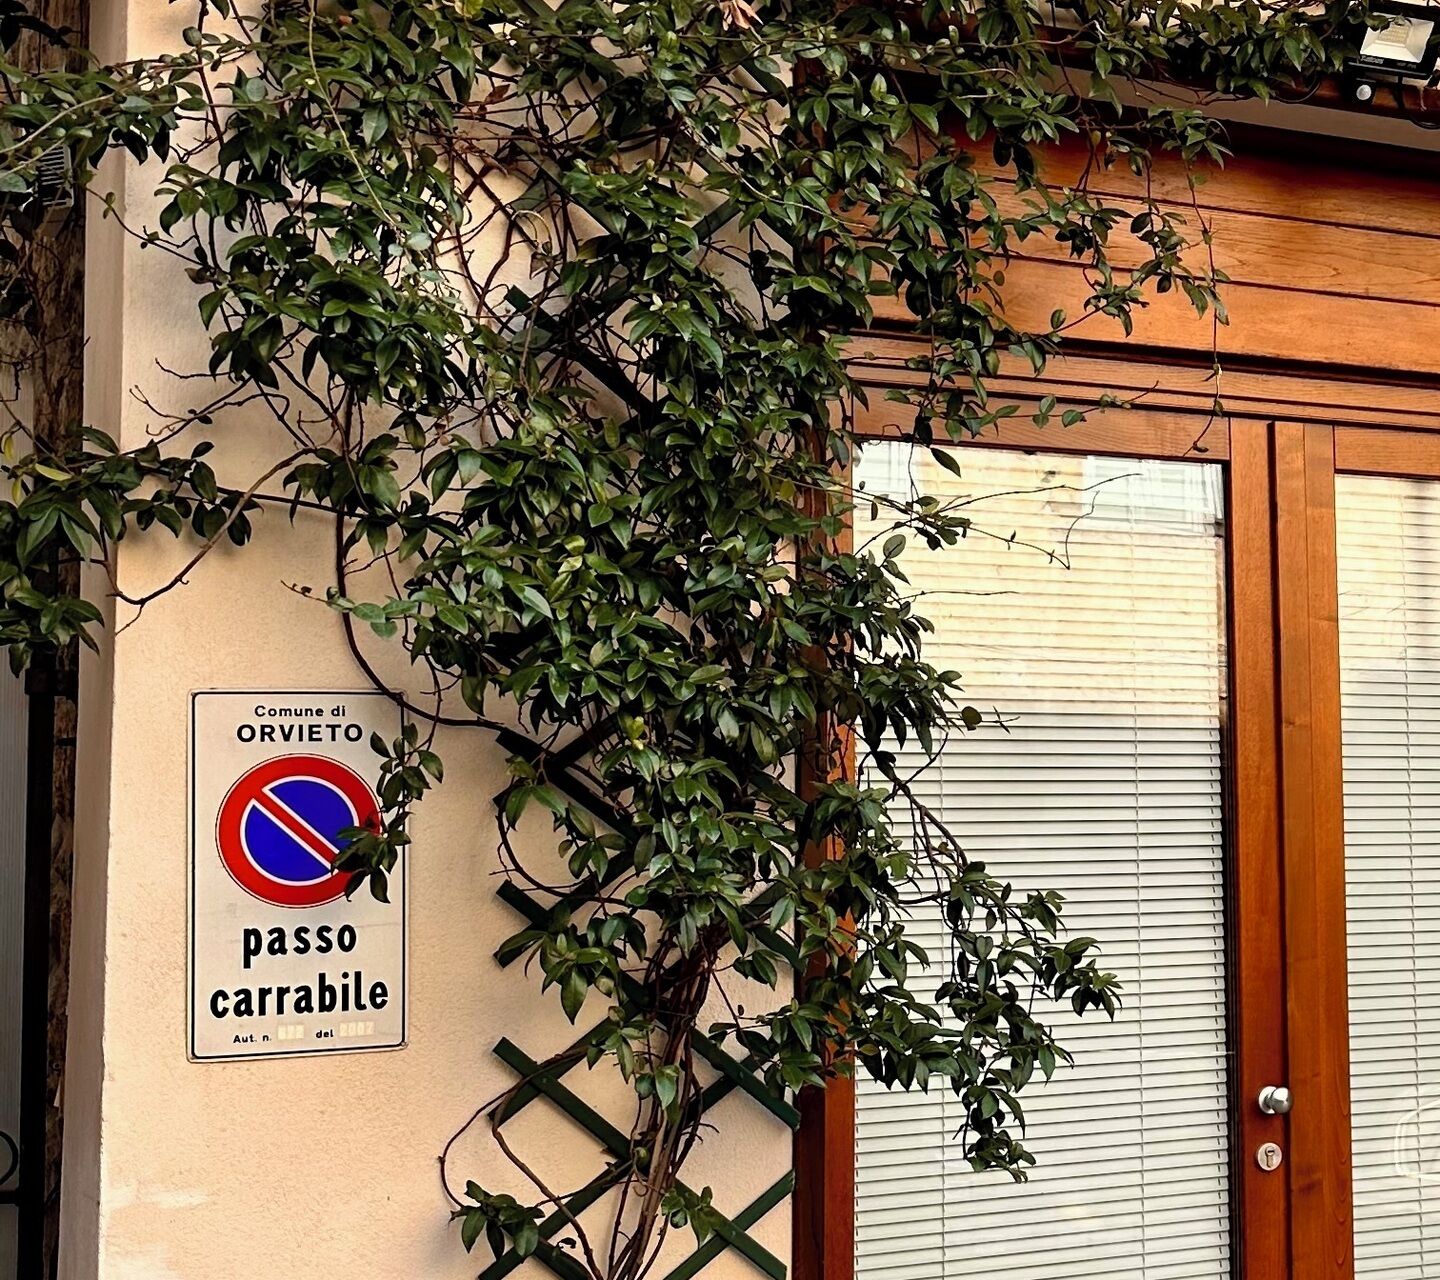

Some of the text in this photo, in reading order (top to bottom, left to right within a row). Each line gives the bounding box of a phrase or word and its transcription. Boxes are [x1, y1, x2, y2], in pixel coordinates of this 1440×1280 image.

[254, 705, 346, 717] Comune di
[236, 724, 363, 743] ORVIETO
[243, 924, 357, 969] passo
[209, 970, 389, 1019] carrabile
[233, 1034, 257, 1044] Aut.
[315, 1029, 334, 1039] del
